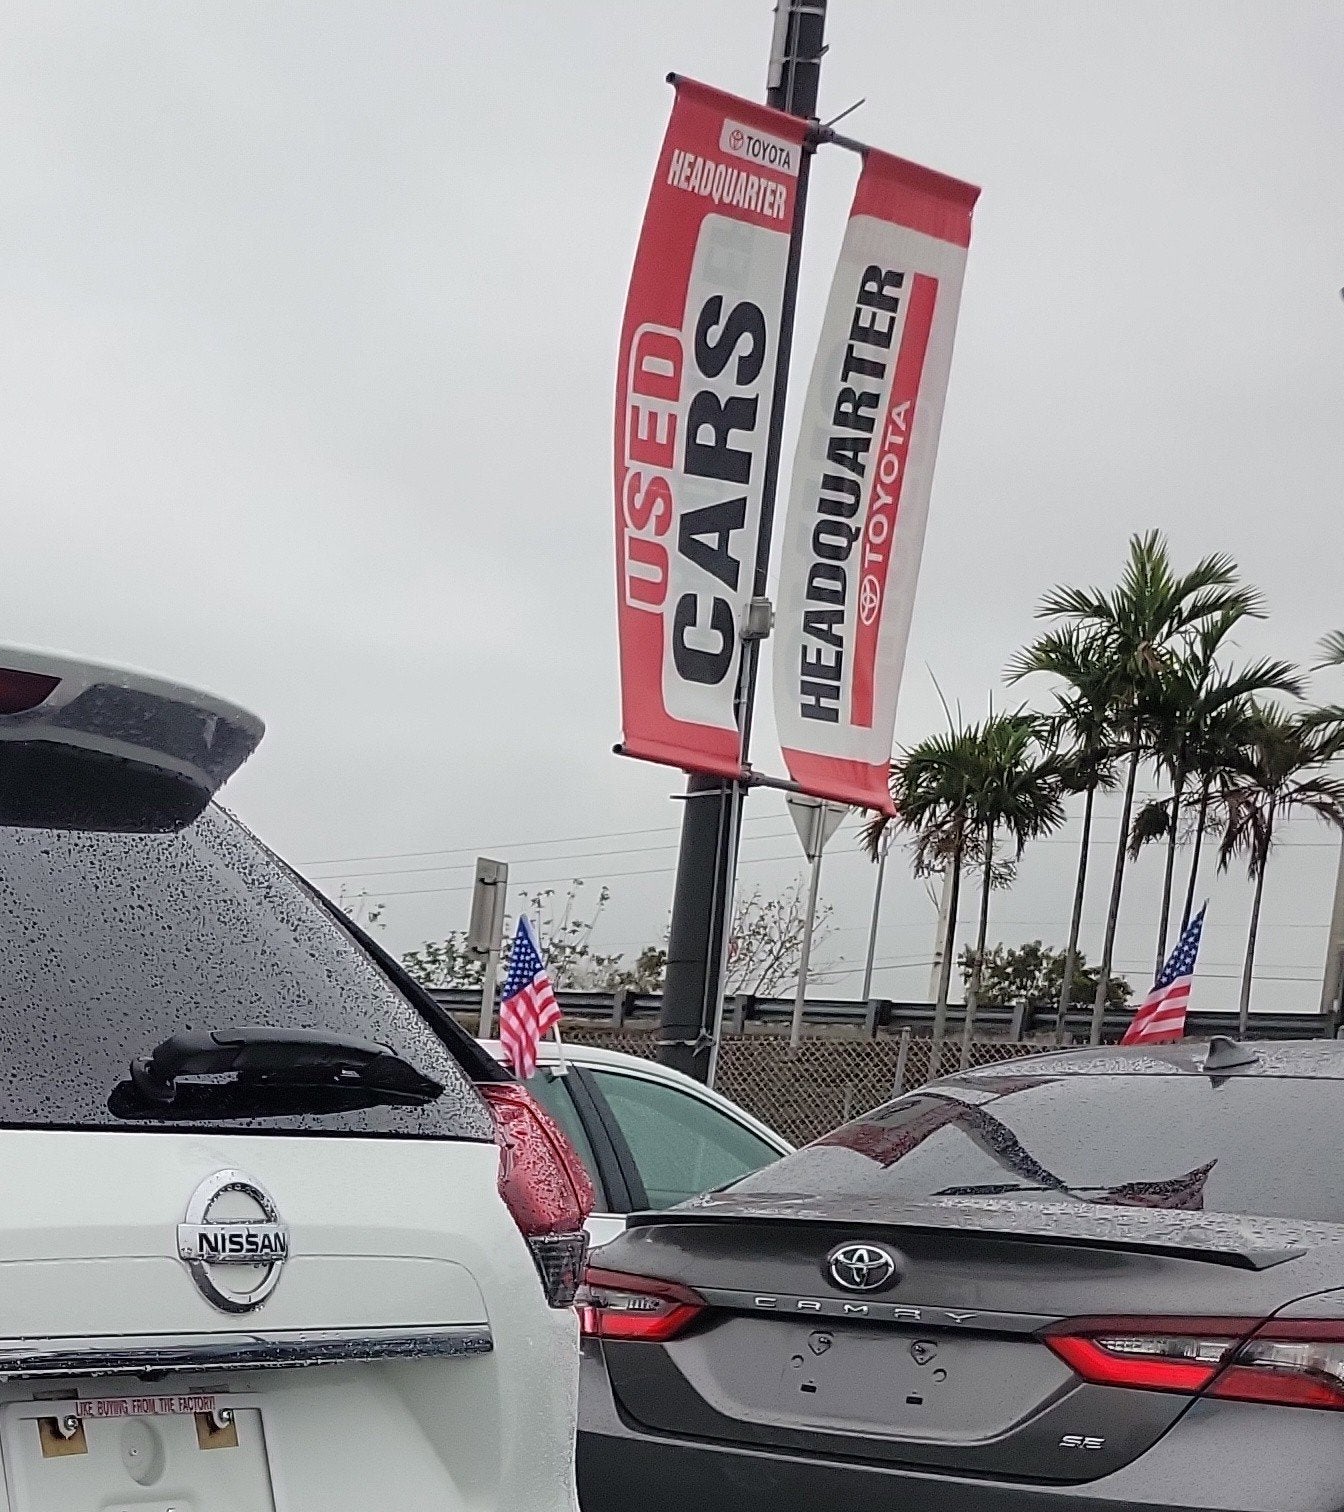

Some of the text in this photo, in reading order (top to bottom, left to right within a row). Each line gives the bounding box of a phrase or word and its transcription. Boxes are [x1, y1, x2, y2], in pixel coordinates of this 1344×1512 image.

[745, 136, 791, 170] TOYOTA
[667, 149, 788, 220] HEADQUARTER
[625, 328, 684, 608] USED
[672, 294, 767, 686] CARS
[800, 264, 906, 724] HEADQUARTER
[865, 400, 911, 567] TOYOTA
[198, 1232, 286, 1253] NISSAN
[754, 1297, 979, 1323] CAMRY
[75, 1400, 93, 1417] LIKE
[132, 1398, 156, 1414] FROM
[159, 1398, 175, 1413] THE
[1058, 1435, 1105, 1449] SE
